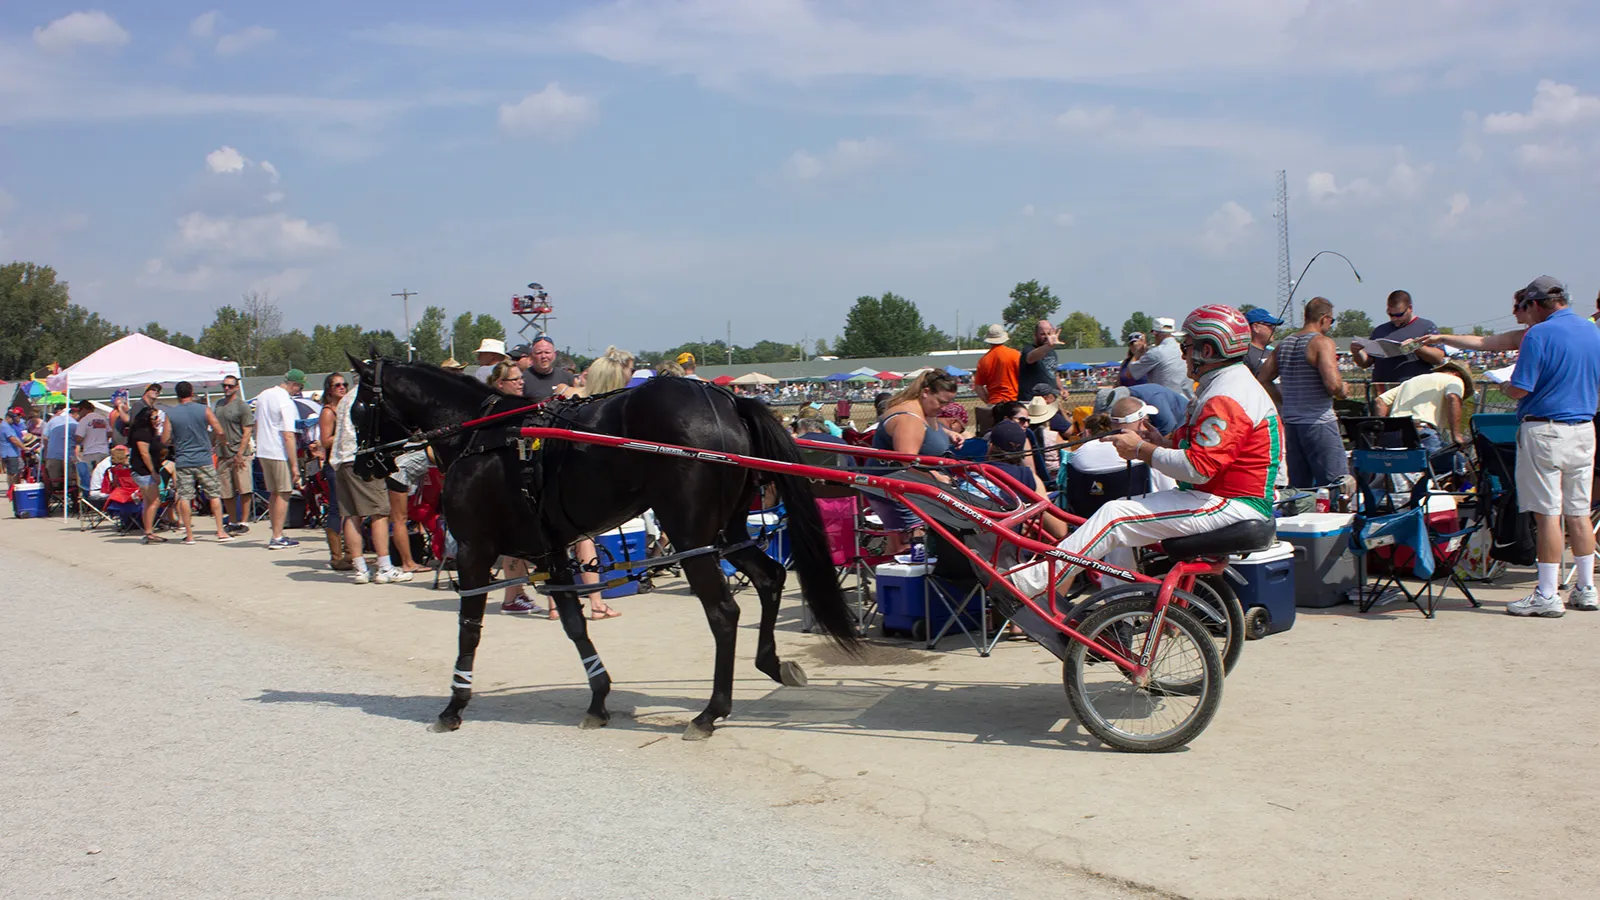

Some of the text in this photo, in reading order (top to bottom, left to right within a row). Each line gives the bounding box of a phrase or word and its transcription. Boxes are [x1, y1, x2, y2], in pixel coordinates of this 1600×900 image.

[1196, 416, 1227, 447] S
[1058, 550, 1122, 576] Premier Trainer
